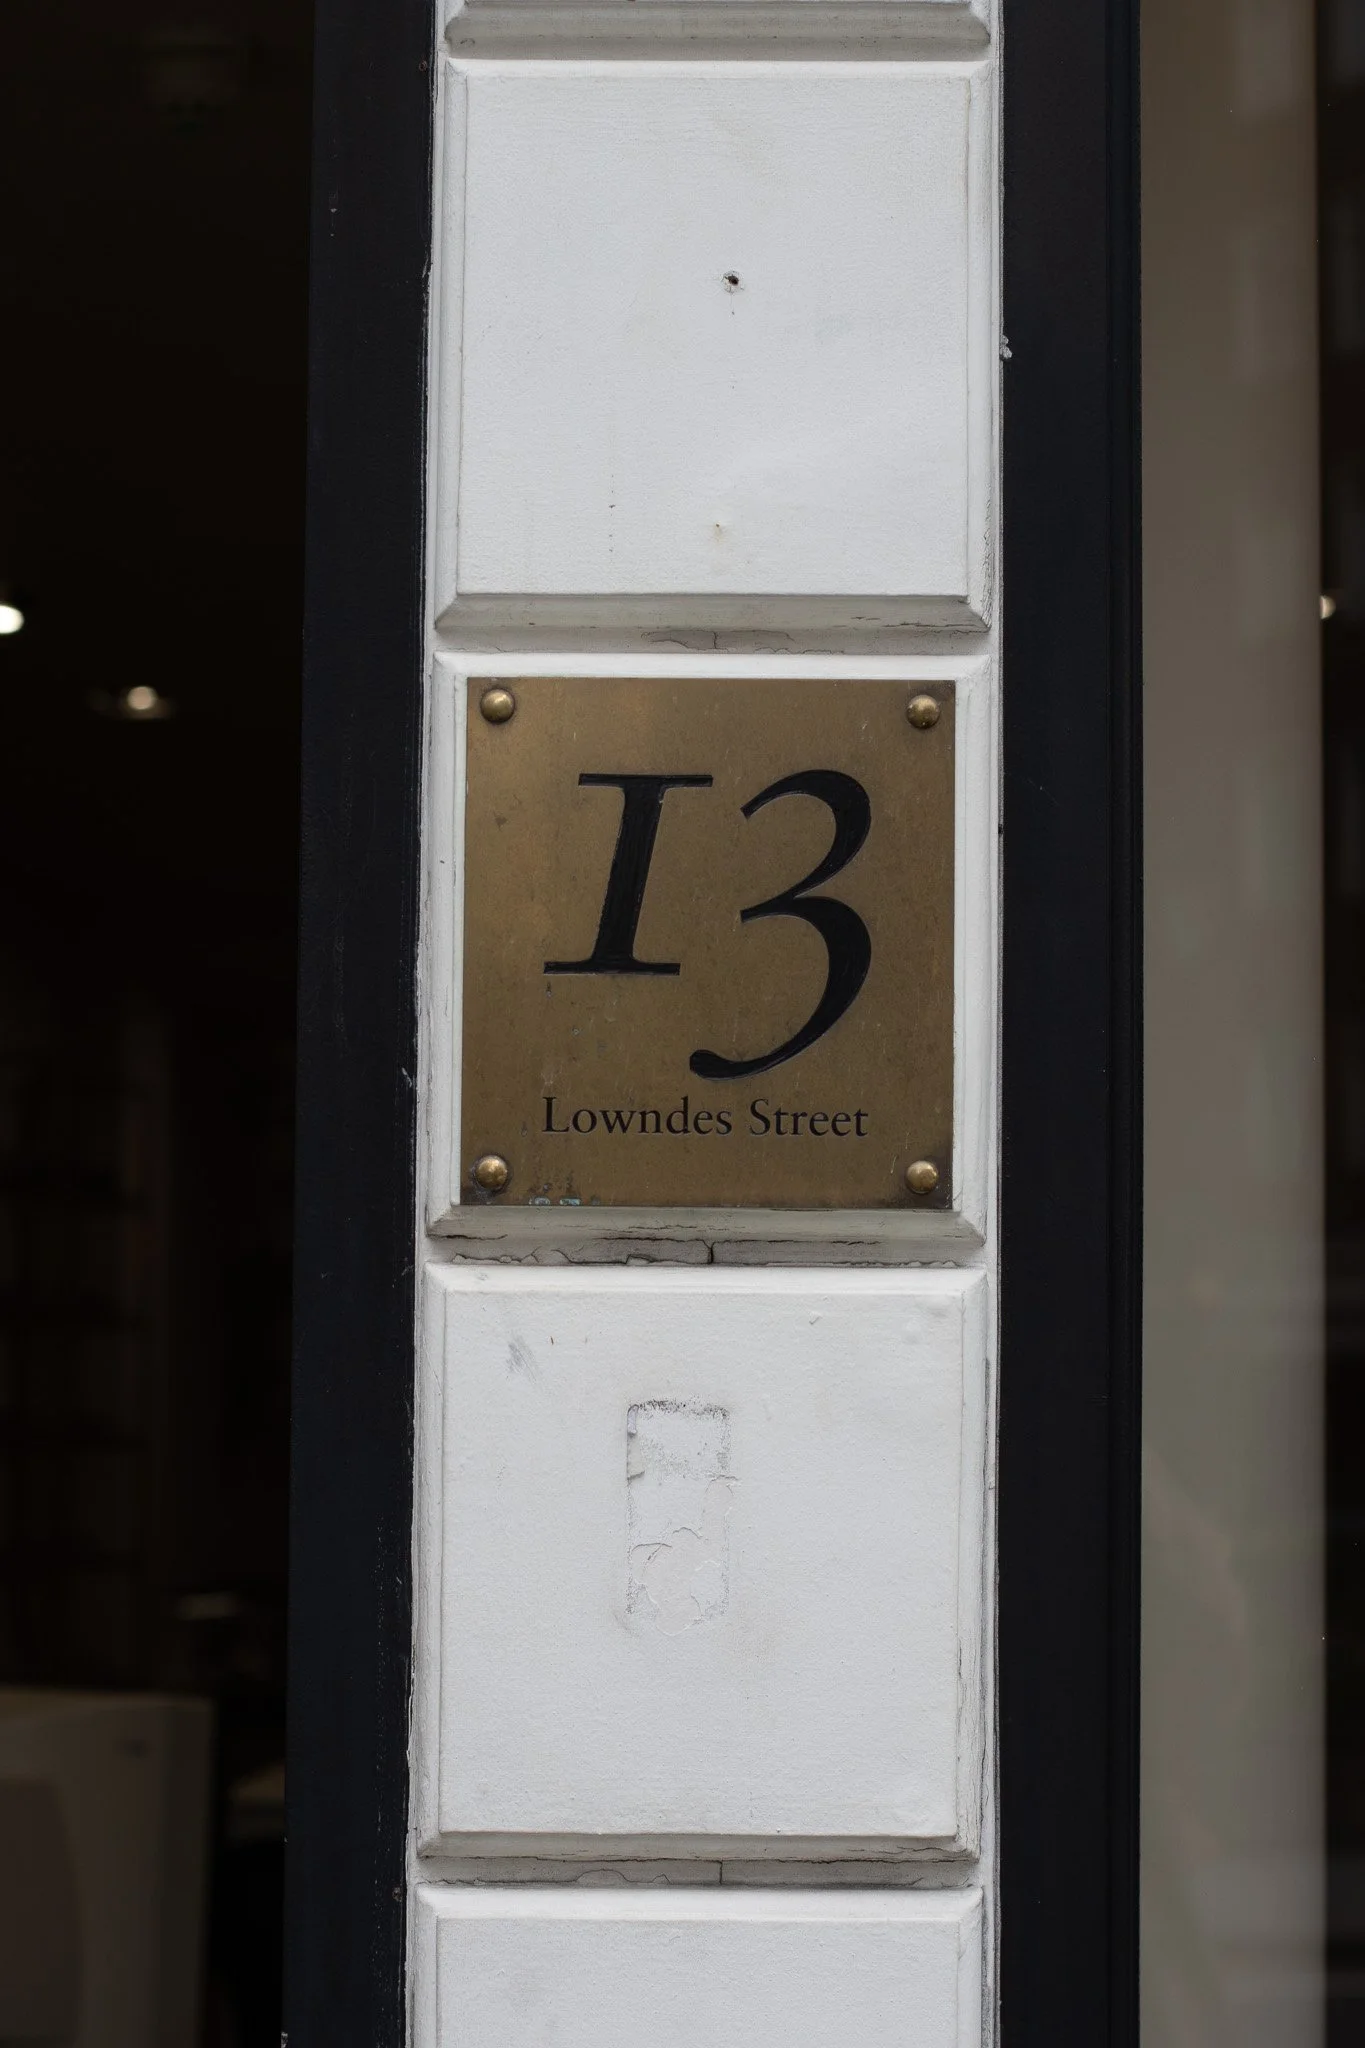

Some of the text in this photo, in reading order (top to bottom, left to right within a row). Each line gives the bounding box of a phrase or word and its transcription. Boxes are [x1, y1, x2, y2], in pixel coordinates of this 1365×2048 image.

[543, 769, 872, 1080] 13
[541, 1095, 869, 1137] Lowndes Street
